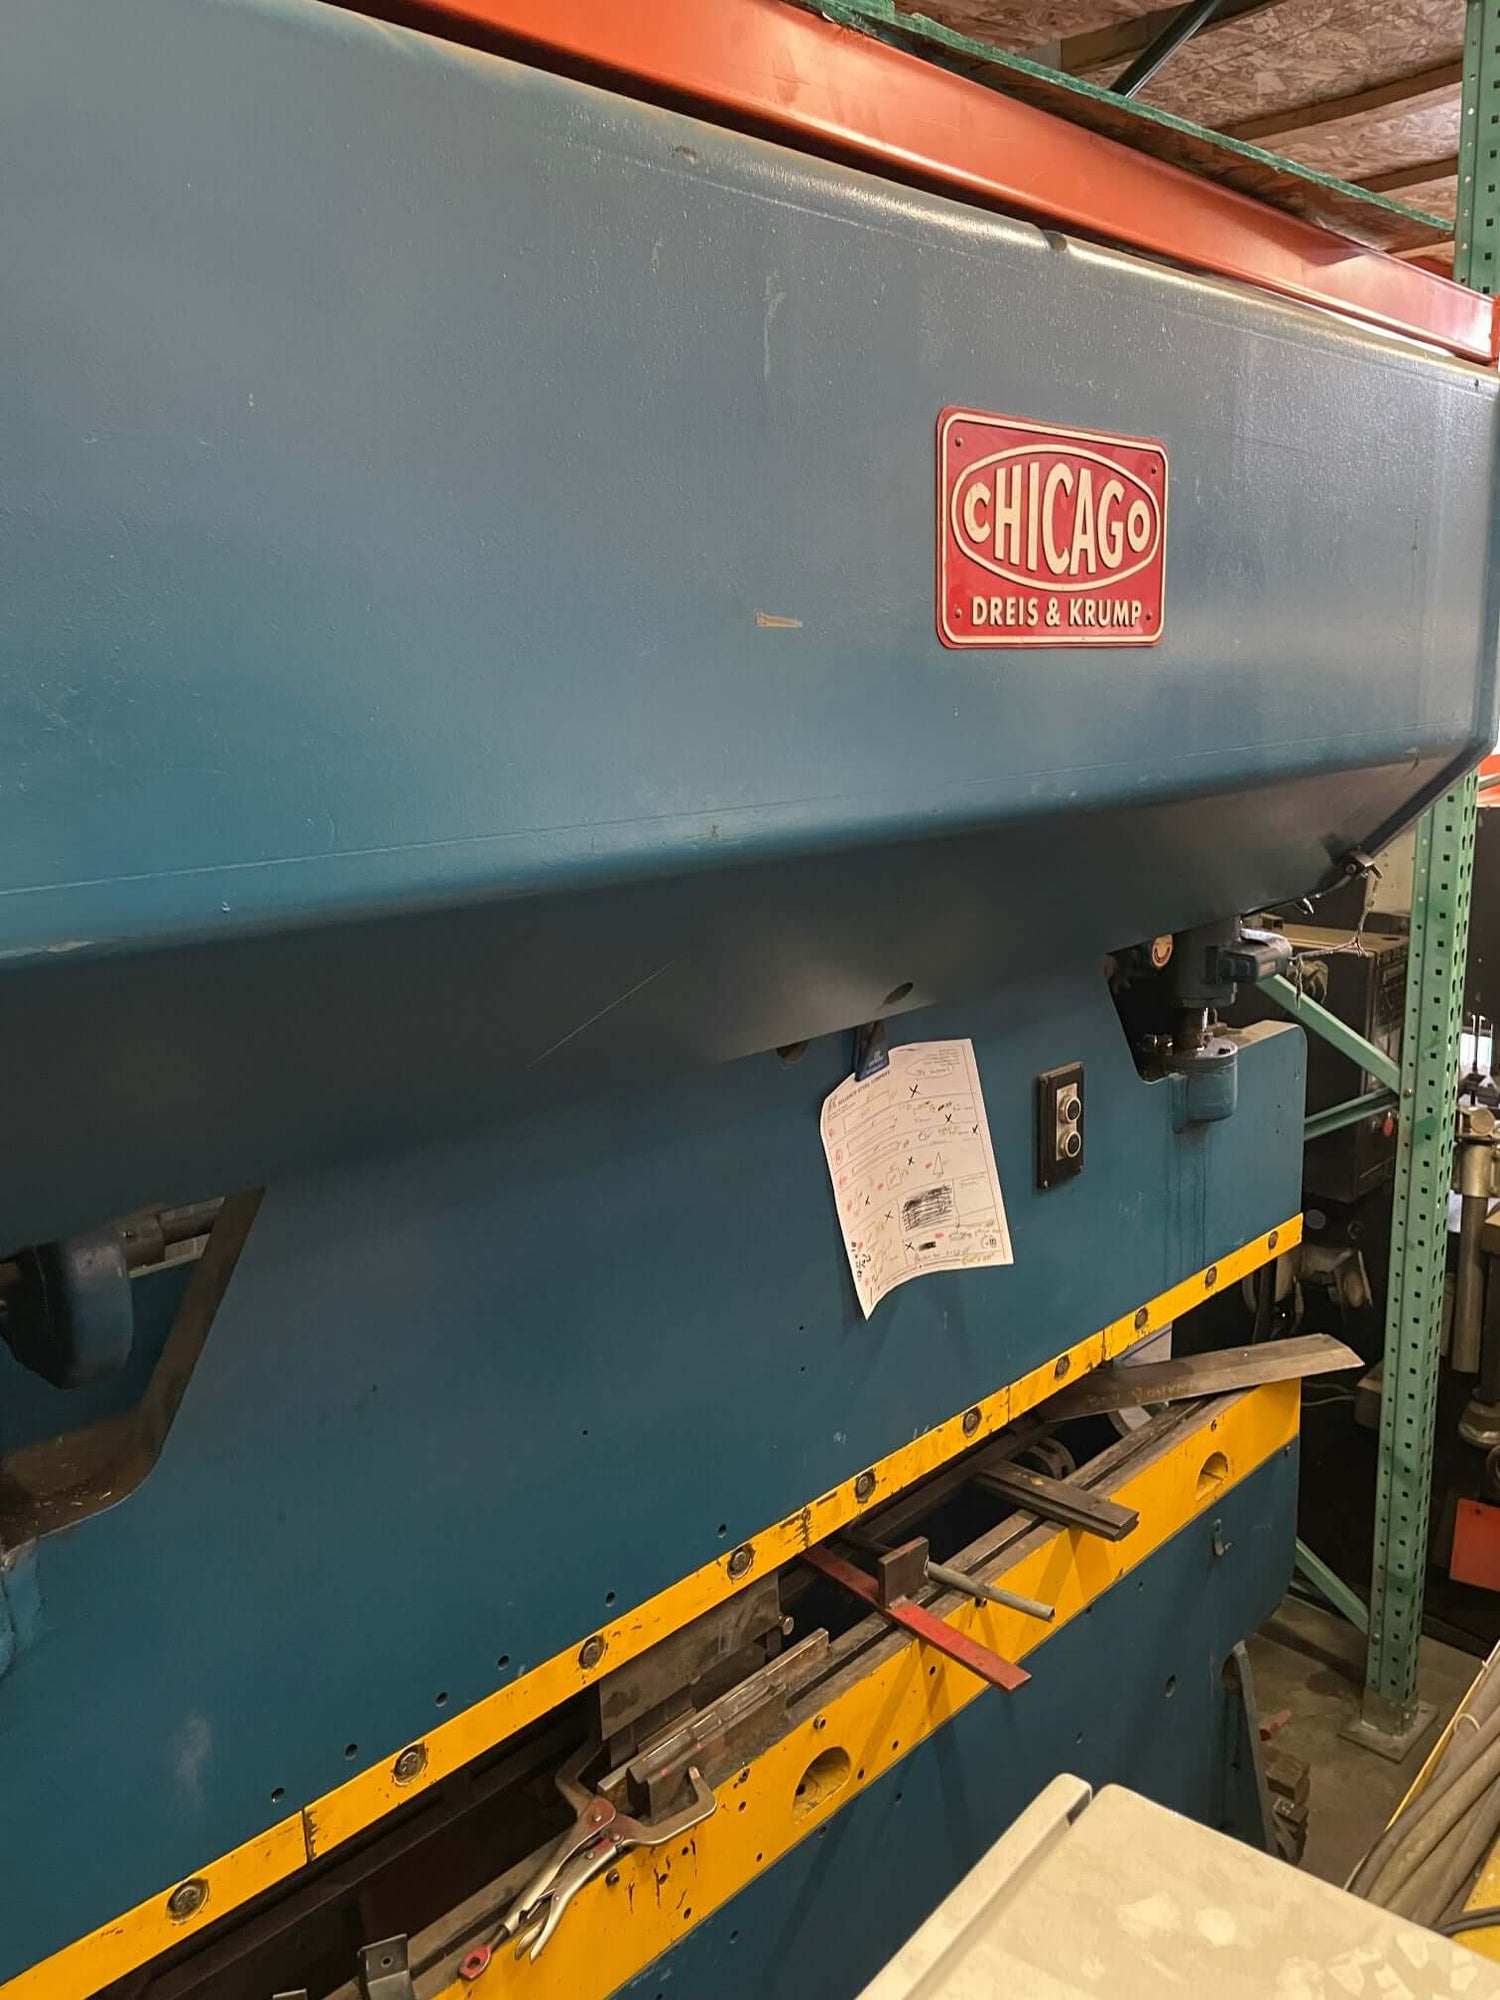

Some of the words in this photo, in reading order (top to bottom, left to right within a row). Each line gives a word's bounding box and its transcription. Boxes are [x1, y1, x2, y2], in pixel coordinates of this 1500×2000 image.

[963, 461, 1151, 576] CHICAGO
[971, 596, 1039, 627] DREIS
[1044, 597, 1062, 627] &
[1069, 597, 1142, 627] KRUMP
